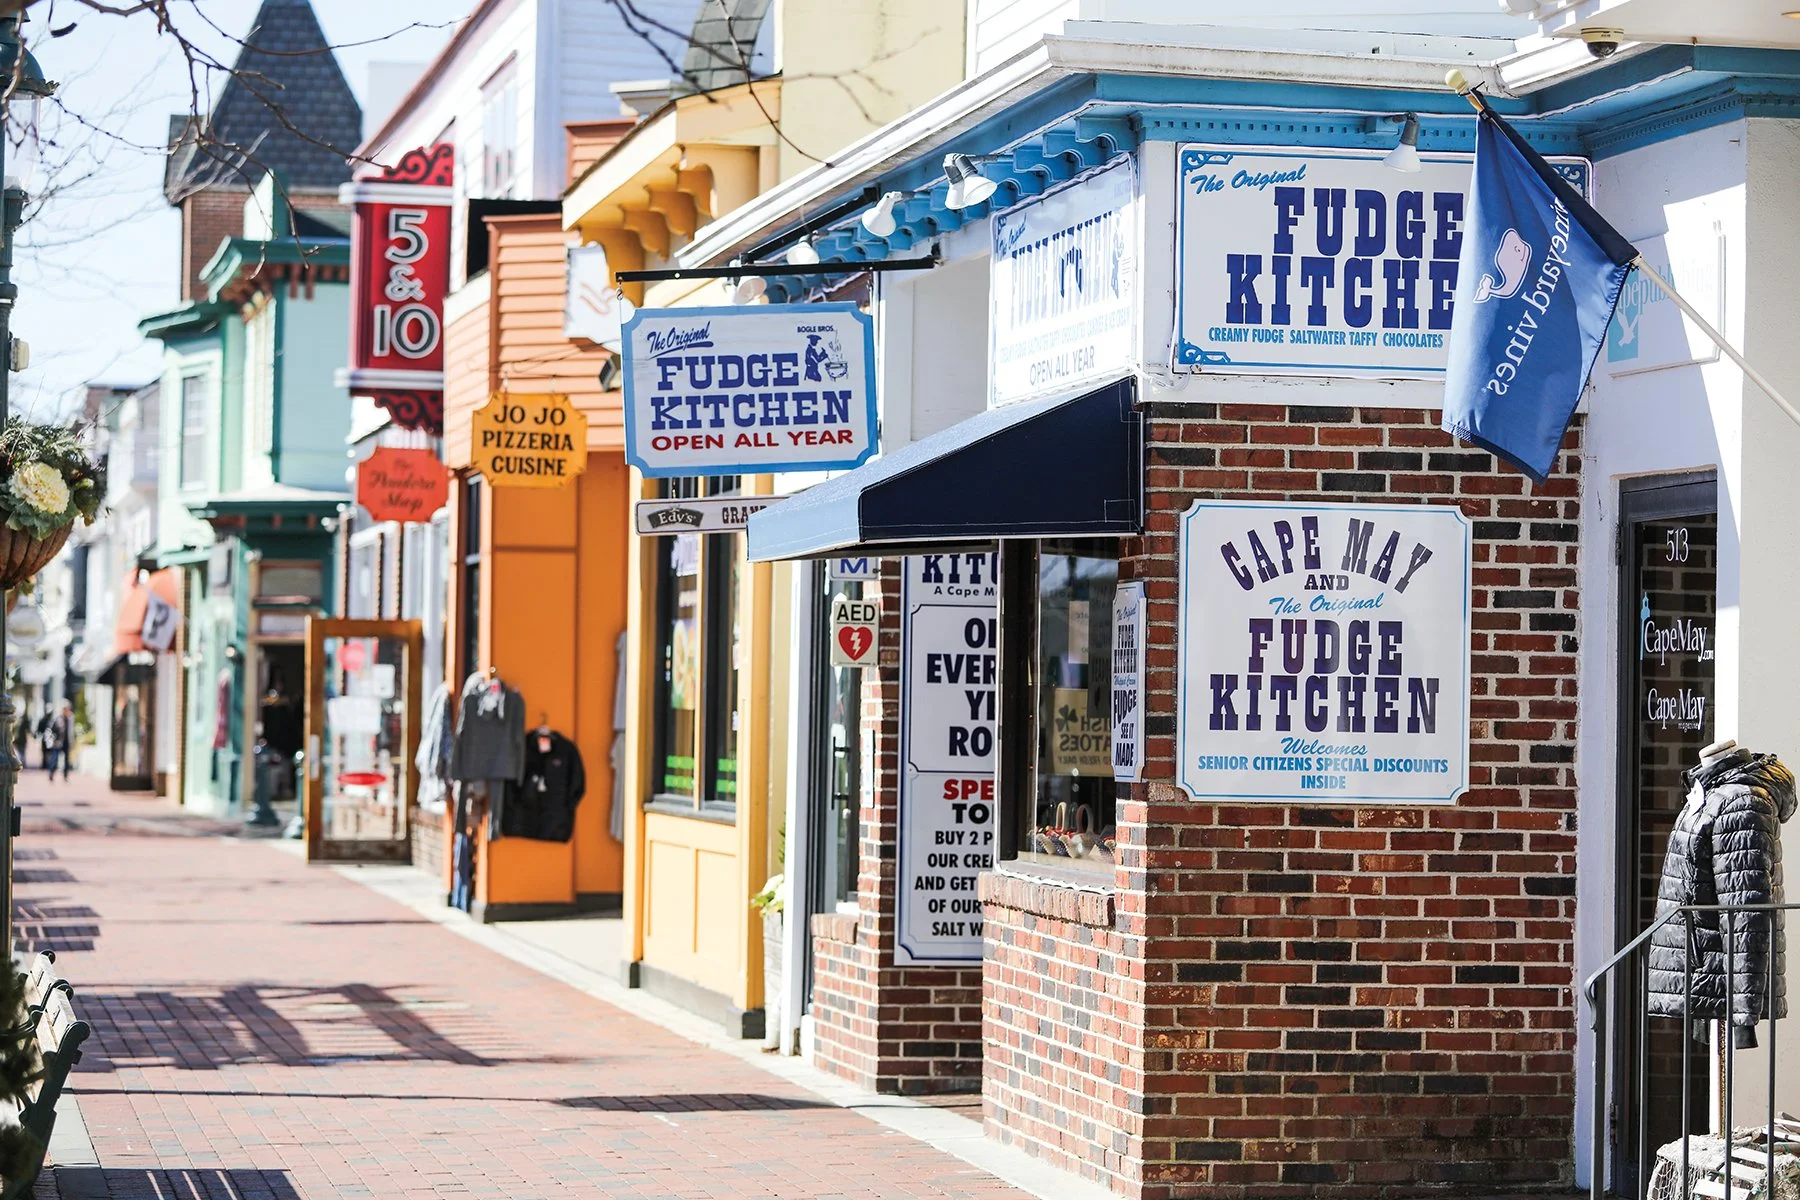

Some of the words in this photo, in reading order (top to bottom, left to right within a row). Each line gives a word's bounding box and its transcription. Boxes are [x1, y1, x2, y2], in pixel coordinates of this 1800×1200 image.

[1190, 175, 1224, 194] The
[1231, 164, 1306, 191] Original
[1274, 186, 1464, 259] FUDGE
[384, 208, 429, 264] 5
[385, 264, 426, 301] &
[373, 303, 440, 359] 10
[647, 328, 666, 354] The
[666, 320, 711, 351] Original
[1208, 327, 1249, 343] CREAMY
[1252, 328, 1284, 344] FUDGE
[1290, 330, 1346, 346] SALTWATER
[1349, 331, 1378, 347] TAFFY
[1383, 332, 1443, 348] CHOCOLATES
[657, 353, 800, 391] FUDGE
[1029, 360, 1052, 386] OPEN
[1055, 356, 1069, 378] ALL
[1072, 346, 1095, 373] YEAR
[494, 405, 526, 425] JO
[534, 407, 566, 426] JO
[650, 390, 852, 430] KITCHEN
[482, 430, 574, 451] PIZZERIA
[651, 434, 724, 451] OPEN
[734, 432, 779, 448] ALL
[787, 429, 853, 446] YEAR
[491, 455, 568, 477] CUISINE
[658, 510, 694, 525] Edy's
[1220, 516, 1321, 591] CAPE
[1341, 517, 1433, 594] MAY
[1666, 527, 1689, 562] 513
[934, 586, 942, 595] A
[947, 586, 979, 598] Cape
[1304, 574, 1349, 591] AND
[836, 603, 876, 621] AED
[1269, 597, 1301, 615] The
[1309, 592, 1383, 616] Original
[1249, 618, 1402, 675] FUDGE
[1114, 689, 1136, 729] FUDGE
[1209, 674, 1439, 733] KITCHEN
[1648, 688, 1677, 729] Cape
[1678, 688, 1706, 730] May
[1129, 723, 1134, 738] IT
[1115, 743, 1134, 766] MADE
[1280, 737, 1368, 756] Welcomes
[1198, 756, 1248, 771] SENIOR
[1253, 756, 1312, 771] CITIZENS
[1316, 757, 1369, 772] SPECIAL
[1373, 758, 1448, 773] DISCOUNTS
[1300, 774, 1346, 789] INSIDE
[935, 831, 965, 845] BUY
[969, 831, 978, 845] 2
[927, 853, 958, 868] OUR
[914, 876, 945, 890] AND
[950, 876, 976, 891] GET
[928, 899, 946, 913] OF
[951, 899, 982, 914] OUR
[932, 921, 965, 936] SALT
